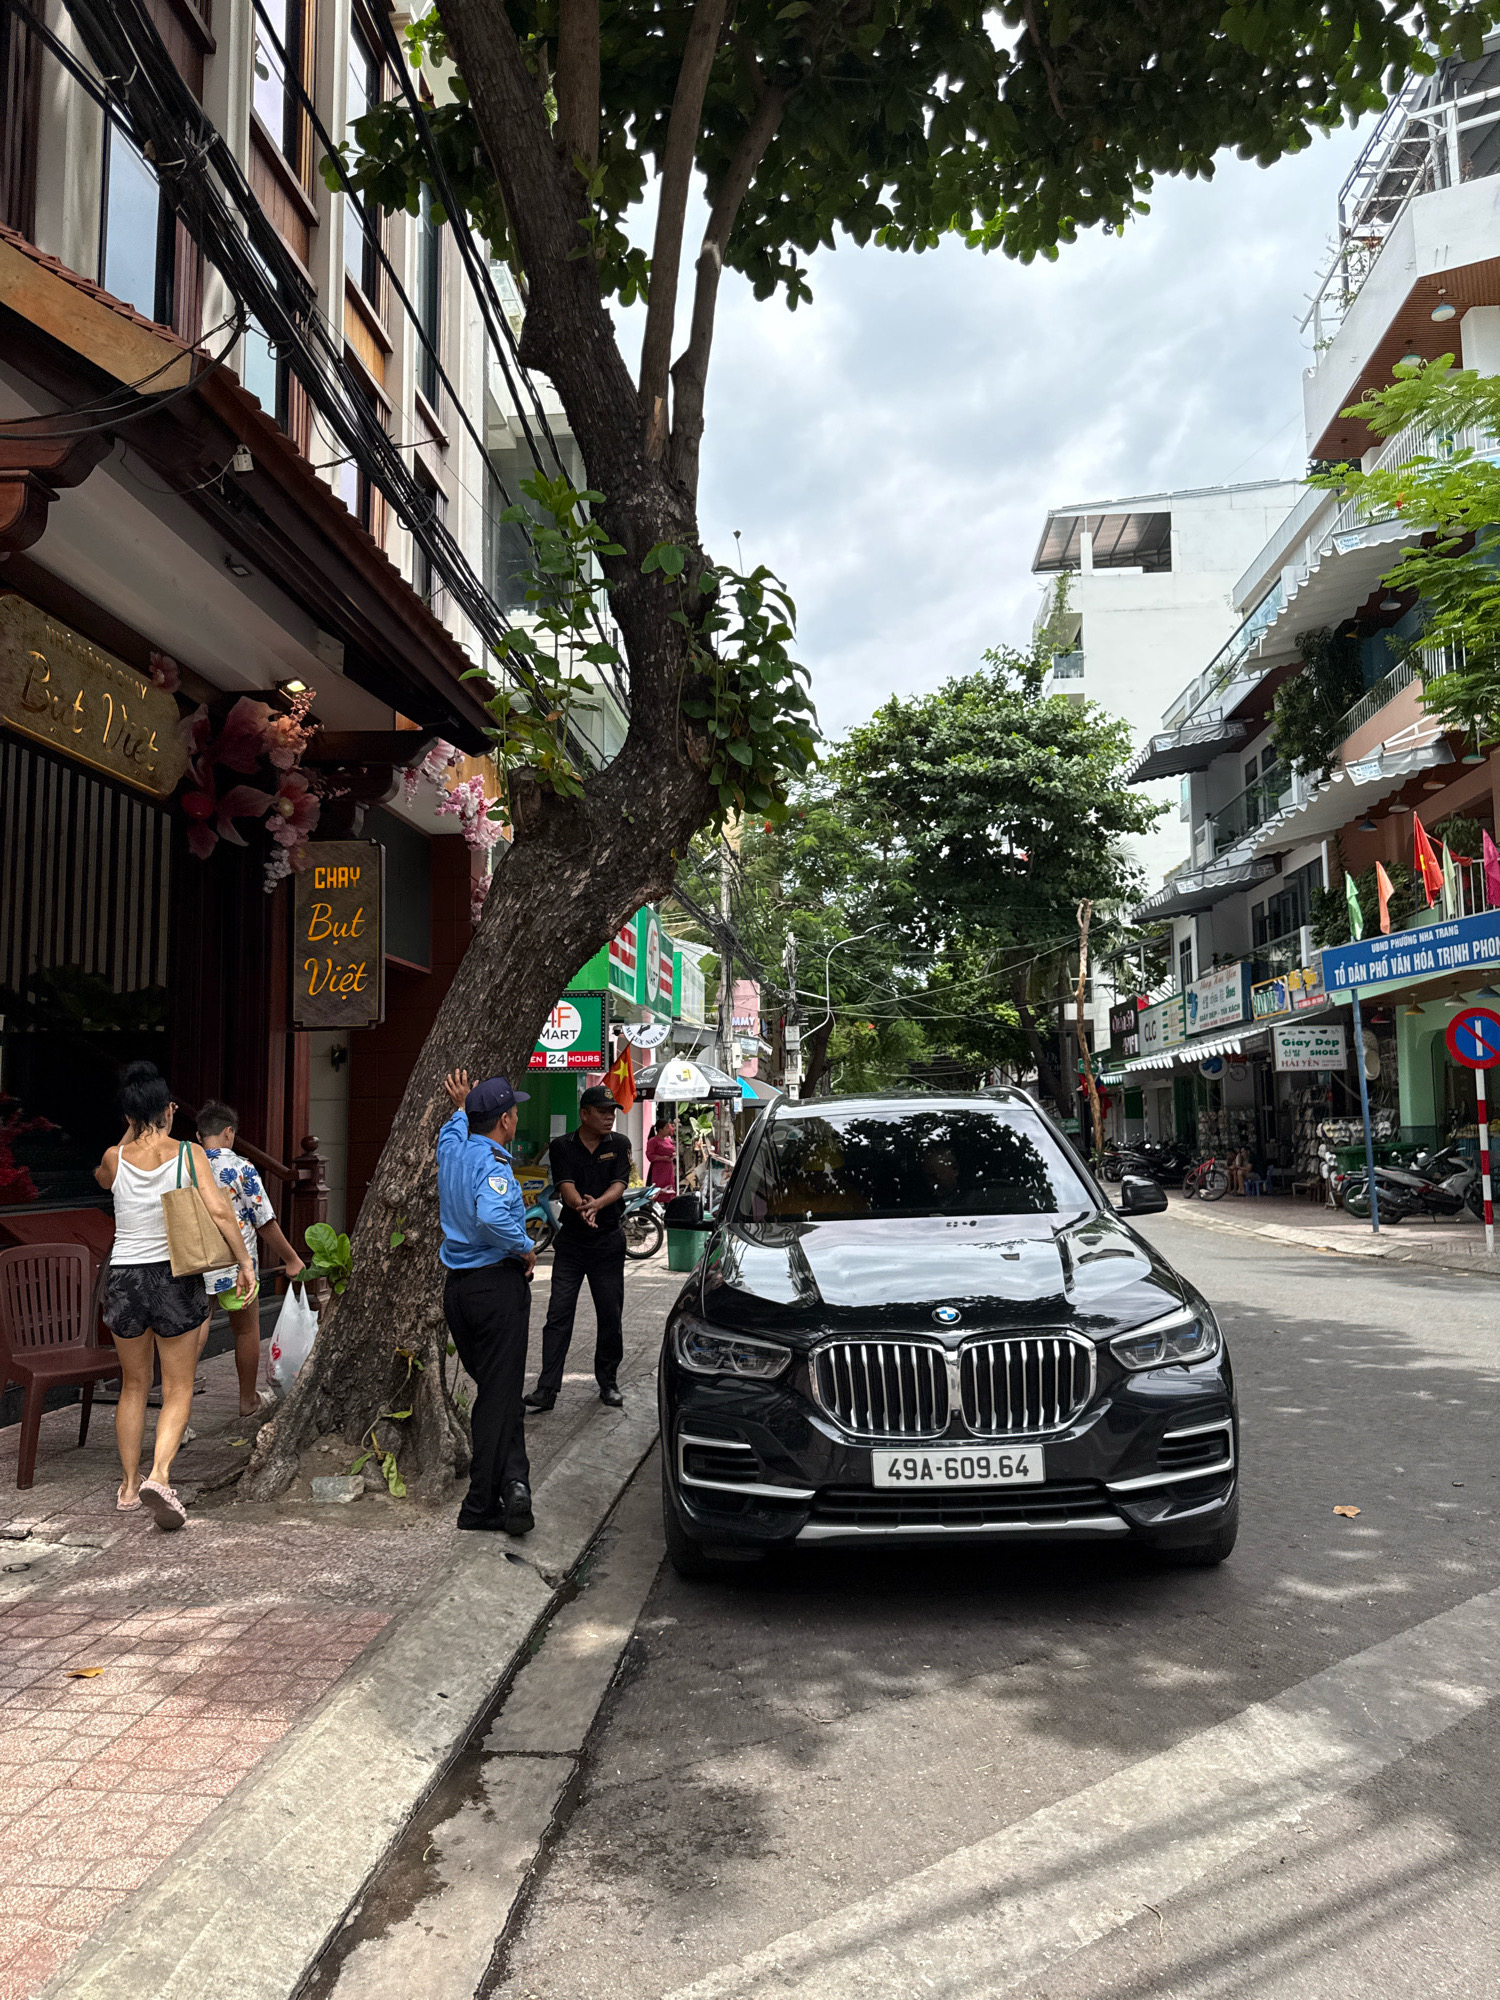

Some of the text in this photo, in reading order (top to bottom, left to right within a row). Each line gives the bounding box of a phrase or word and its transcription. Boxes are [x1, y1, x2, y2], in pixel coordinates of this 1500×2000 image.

[20, 650, 159, 777] Bụt Việt
[314, 866, 361, 889] CHAY
[307, 903, 366, 945] Bụt
[1371, 940, 1389, 953] UBND
[1418, 930, 1434, 943] NHA
[1435, 924, 1459, 939] TRANG
[1334, 960, 1346, 986] TỔ
[1348, 961, 1368, 984] DÂN
[1369, 953, 1389, 980] PHỐ
[1390, 952, 1411, 976] VĂN
[1413, 947, 1435, 972] HÓA
[1437, 942, 1470, 969] TRỊNH
[304, 957, 369, 1000] Việt
[541, 1028, 578, 1040] MART
[645, 1036, 660, 1045] NAIL
[548, 1054, 566, 1065] 24
[568, 1055, 600, 1063] HOURS
[888, 1454, 1030, 1481] 49A-609.64
